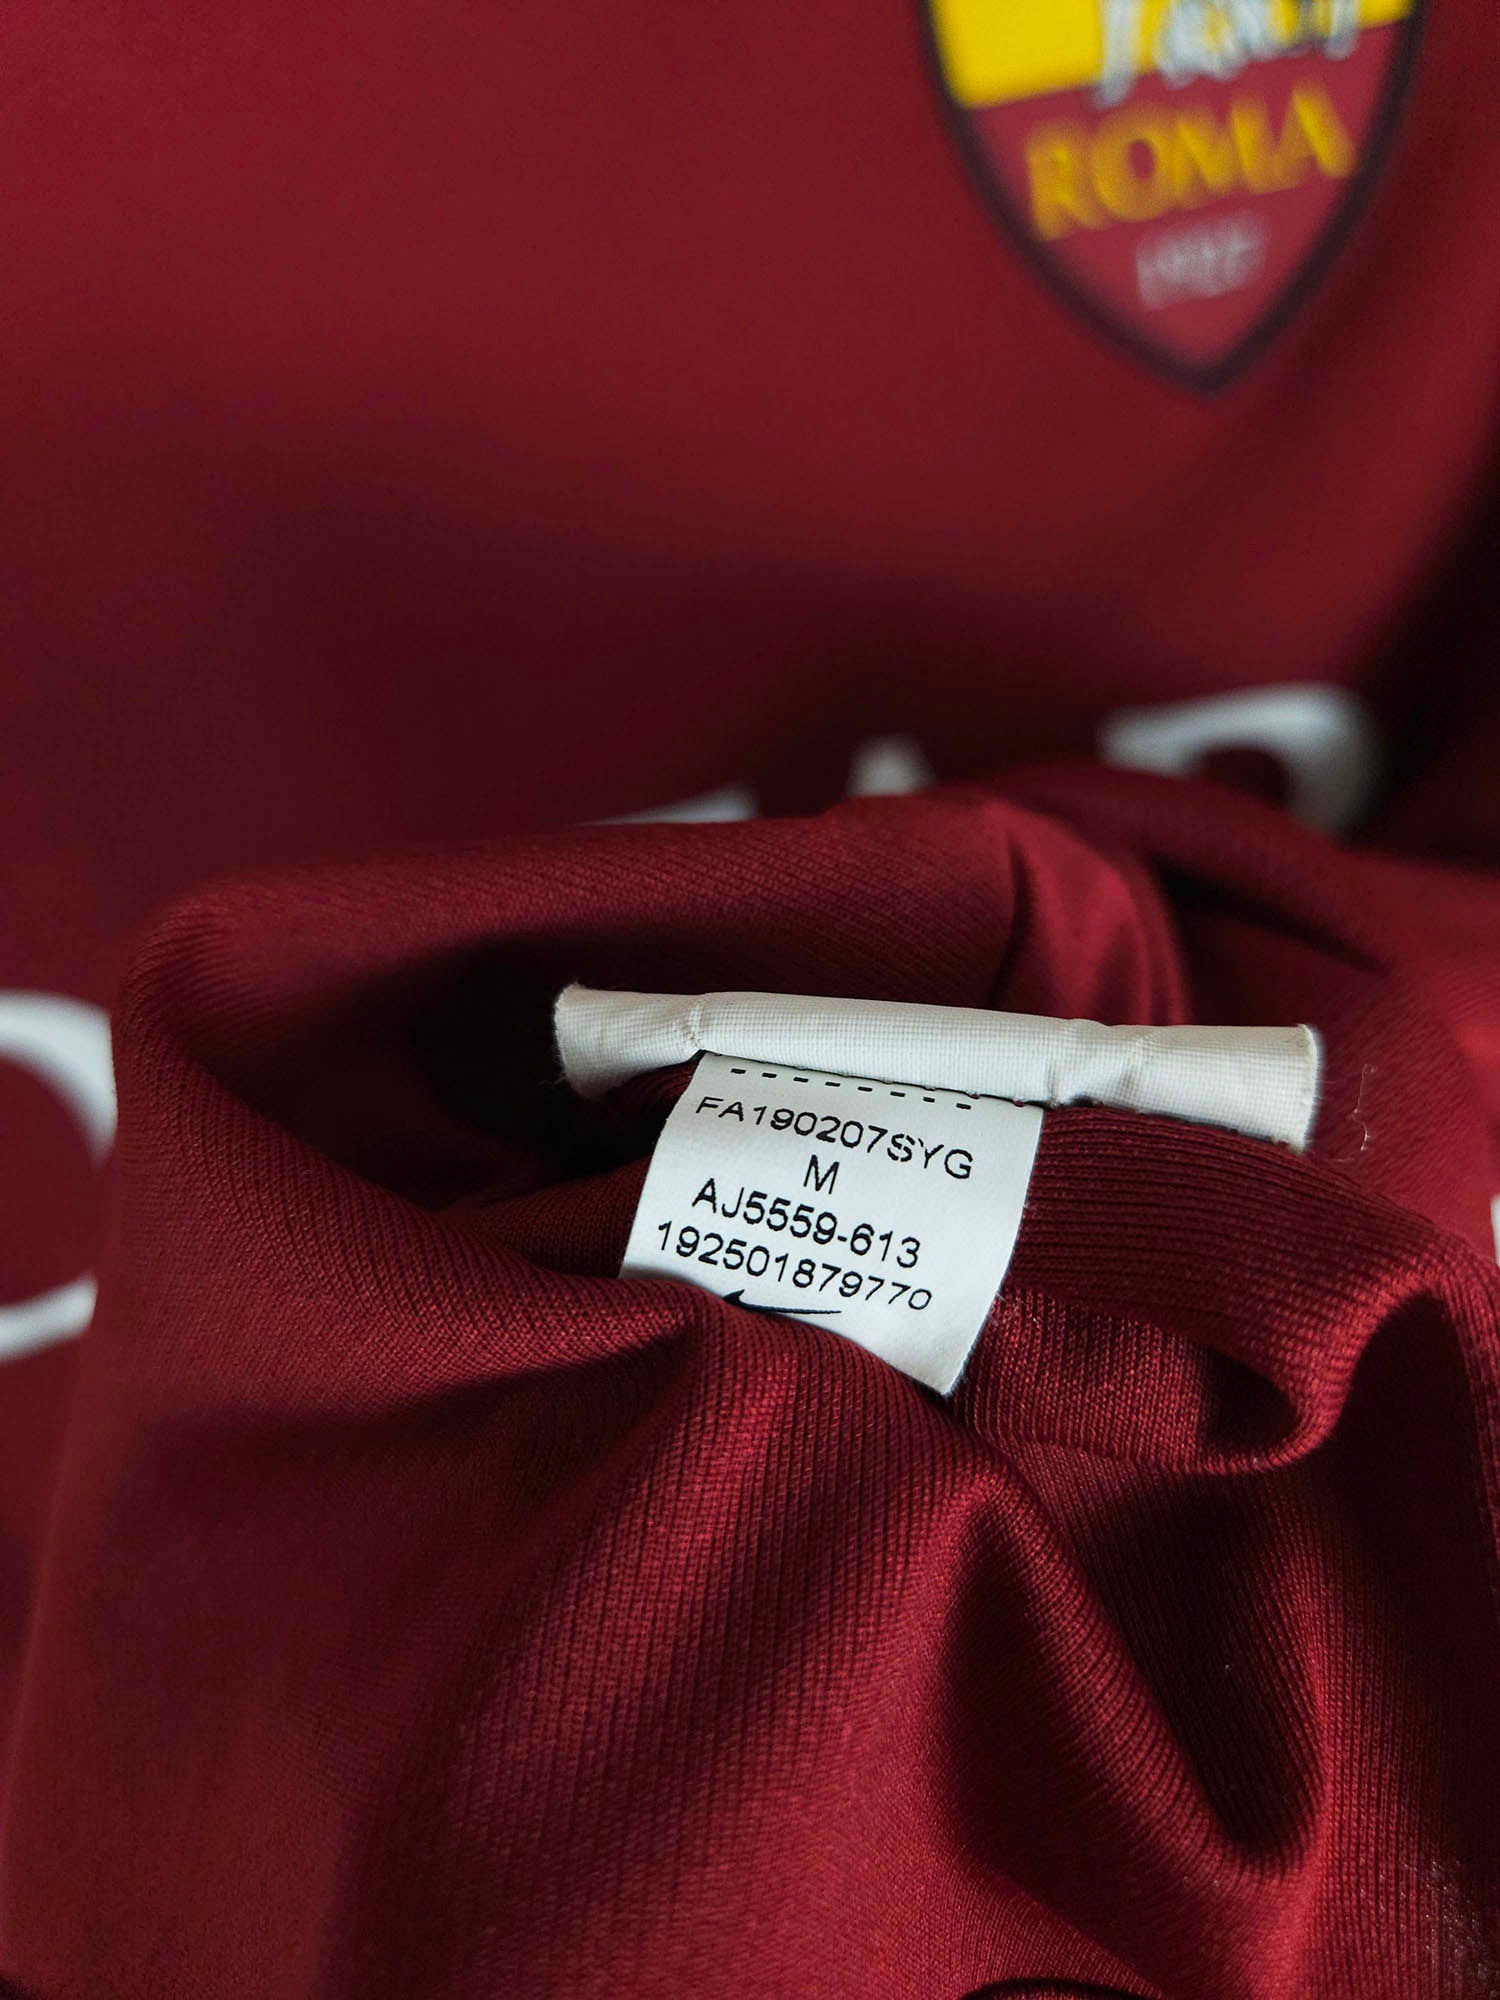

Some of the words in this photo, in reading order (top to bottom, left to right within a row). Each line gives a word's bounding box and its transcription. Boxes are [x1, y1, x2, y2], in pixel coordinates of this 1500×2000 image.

[1027, 84, 1357, 241] ROMA
[696, 1096, 973, 1180] FA190207SYG
[803, 1154, 841, 1195] M
[657, 1221, 933, 1311] 192501879770
[691, 1178, 921, 1269] AJ5559-613
